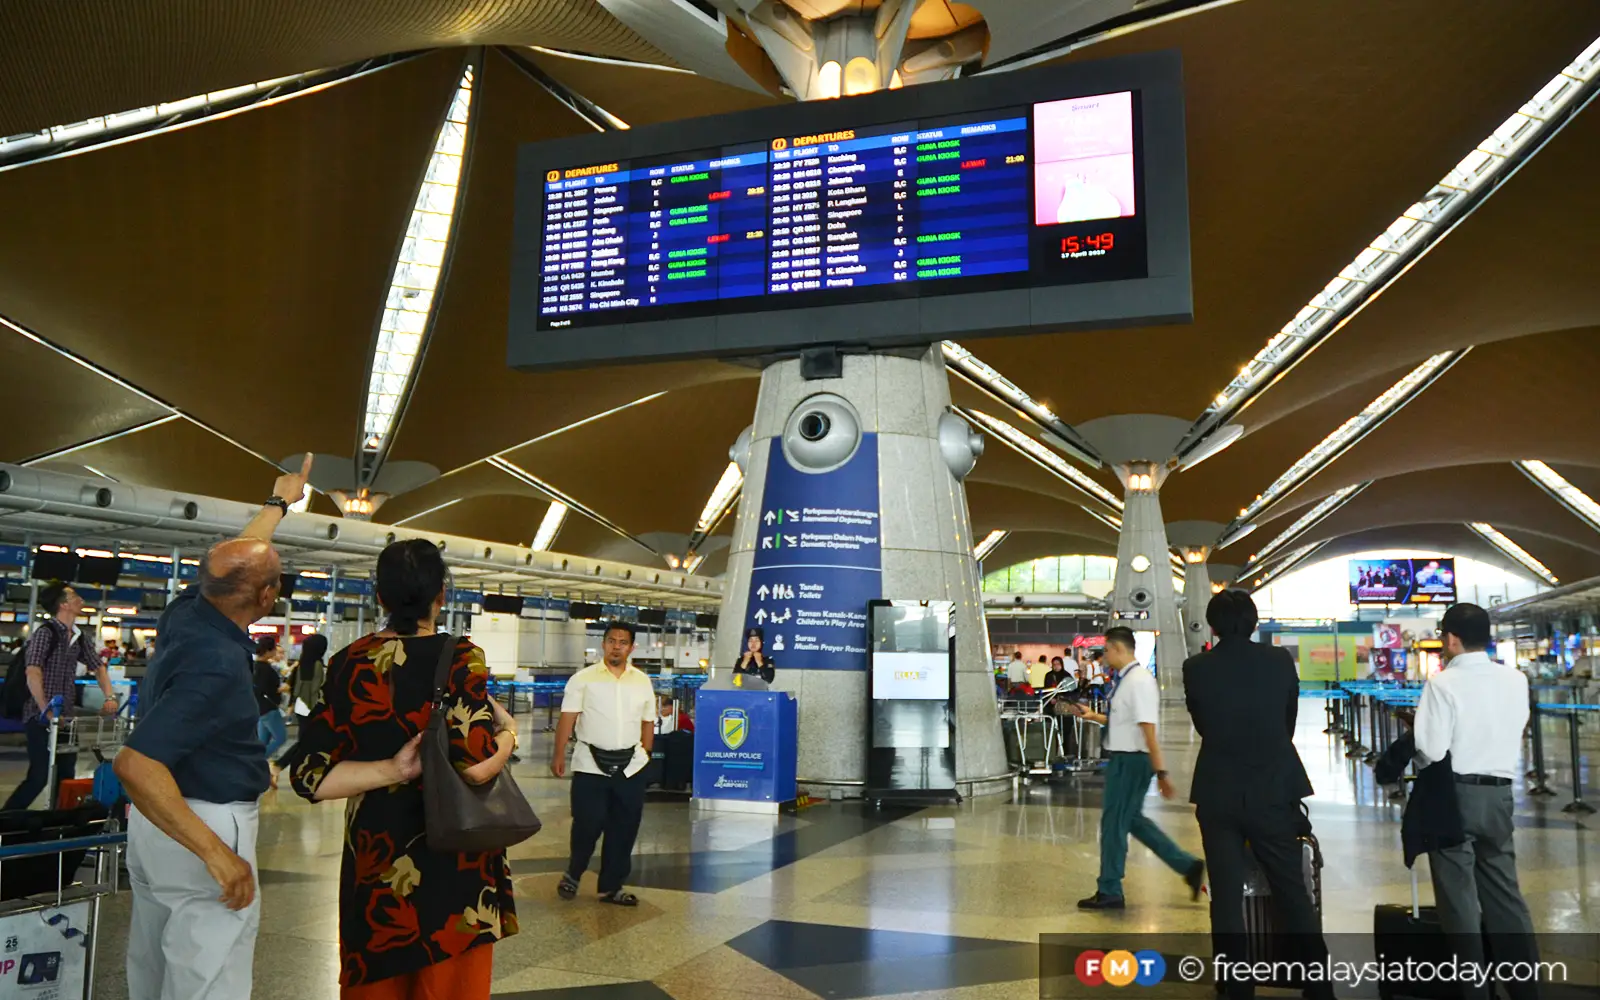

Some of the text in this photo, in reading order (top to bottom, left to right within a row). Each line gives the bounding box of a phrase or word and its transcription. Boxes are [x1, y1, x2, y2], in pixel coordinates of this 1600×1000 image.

[793, 130, 855, 146] DEPARTURES
[793, 147, 818, 156] FLIGHT
[828, 144, 839, 152] TO
[891, 135, 909, 144] ROW
[917, 131, 943, 139] STATUS
[961, 124, 996, 134] REMARKS
[565, 163, 618, 178] DEPARTURES
[565, 179, 587, 187] FLIGHT
[671, 164, 694, 173] STATUS
[710, 158, 741, 167] REMARKS
[827, 209, 862, 218] Singapore
[827, 222, 846, 230] Doha
[827, 231, 857, 241] Bangkok
[1061, 232, 1114, 253] 15:49
[1070, 250, 1088, 258] April
[625, 298, 639, 306] City
[799, 583, 824, 591] Tandas
[799, 591, 822, 599] Toilets
[796, 618, 830, 626] Children's
[830, 619, 847, 628] Play
[794, 634, 817, 642] Surau
[793, 642, 819, 650] Muslim
[820, 644, 844, 653] Prayer
[6, 938, 18, 949] 25
